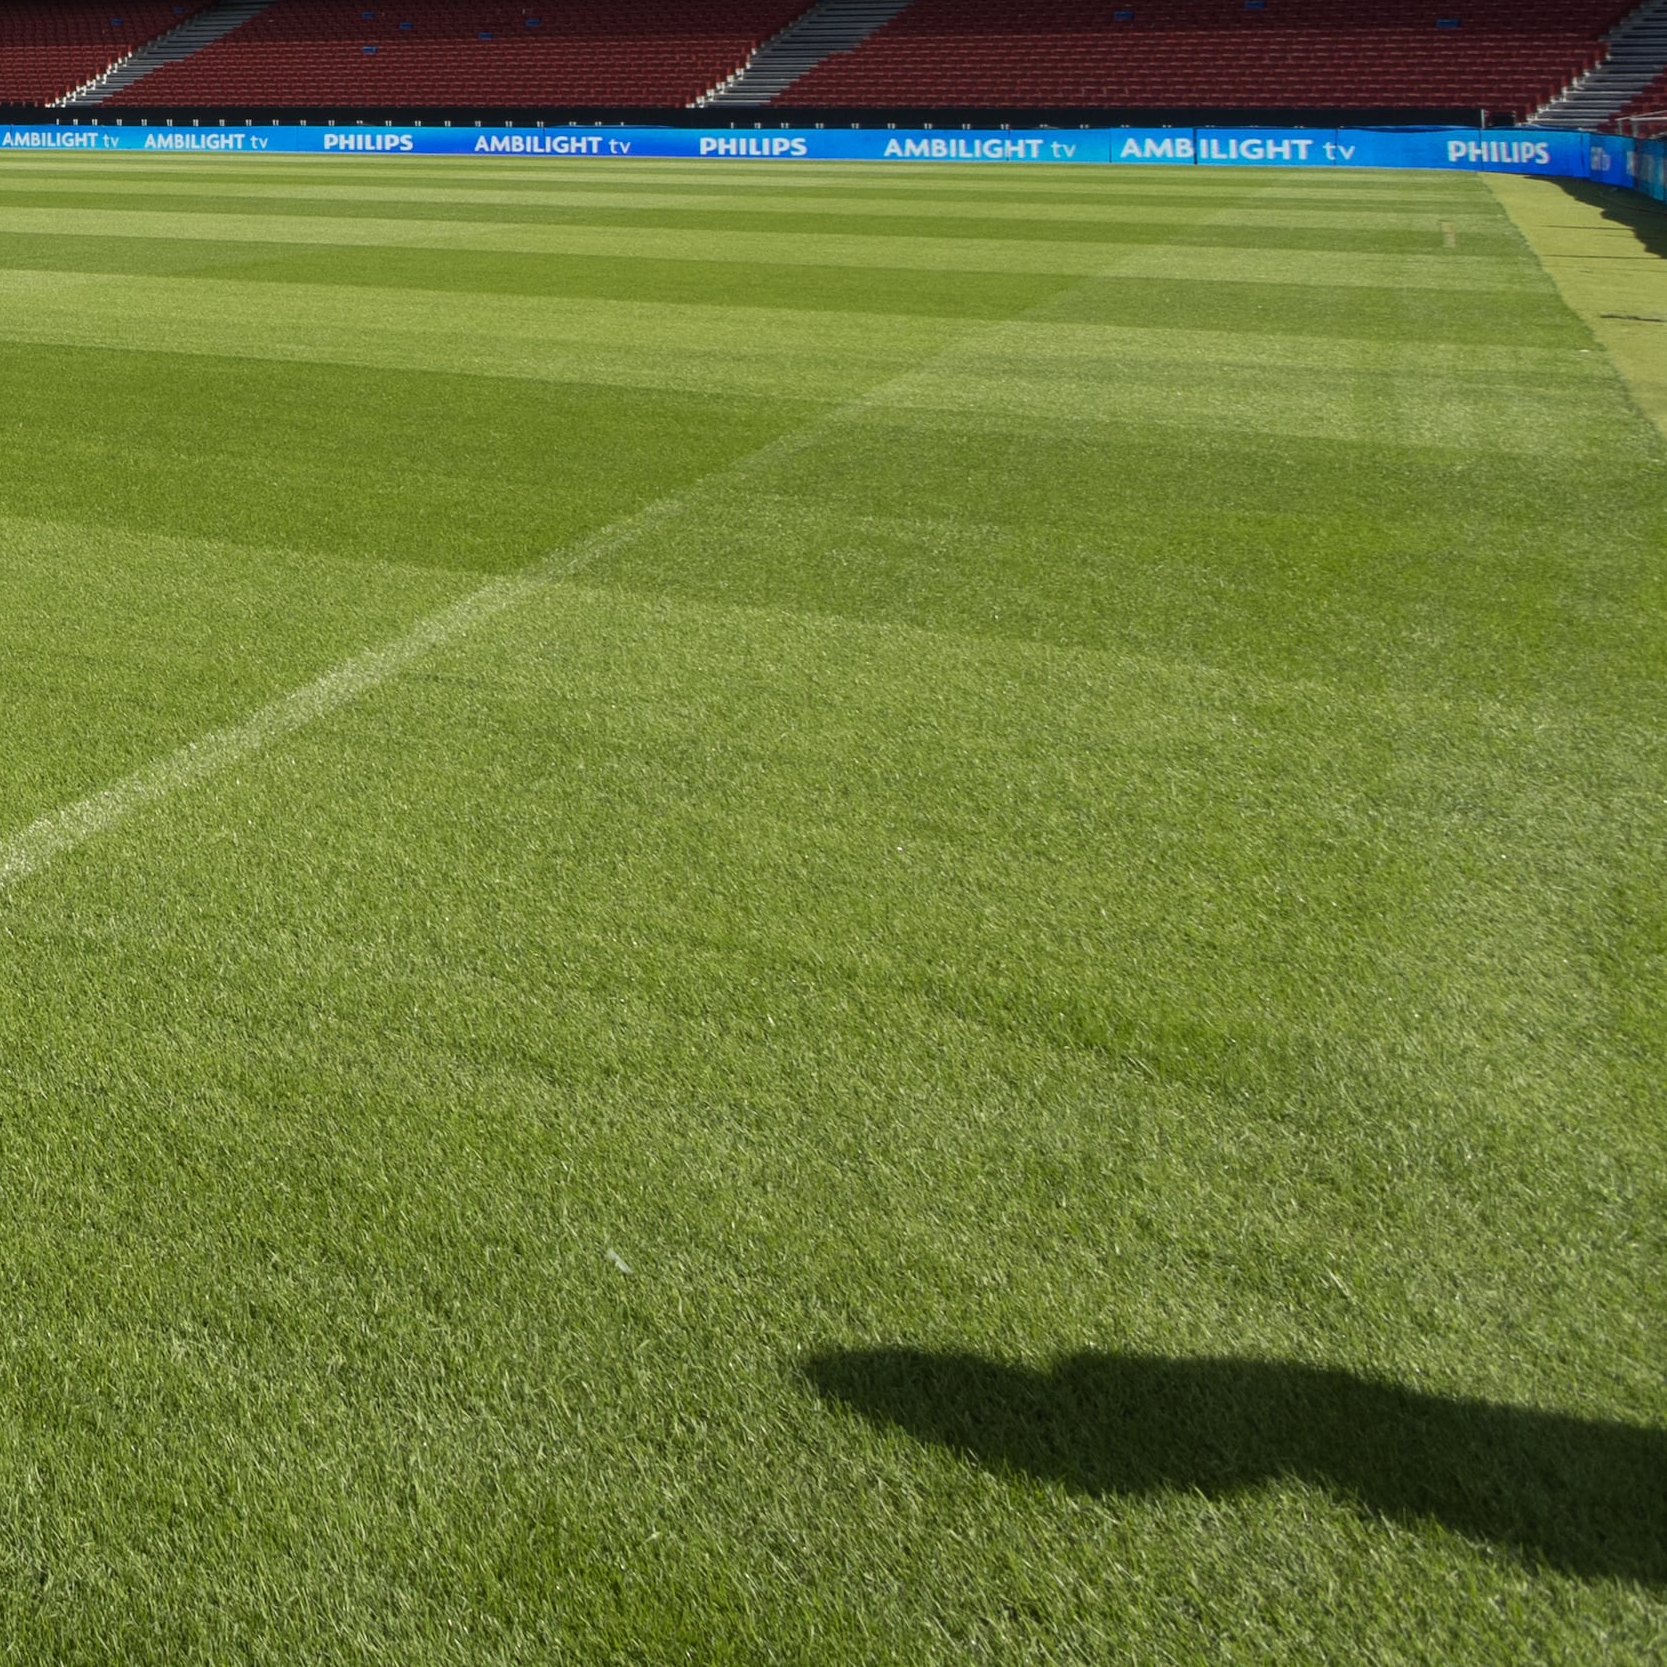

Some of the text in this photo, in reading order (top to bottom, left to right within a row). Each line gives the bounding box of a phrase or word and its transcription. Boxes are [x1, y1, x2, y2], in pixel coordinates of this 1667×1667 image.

[2, 132, 119, 148] AMBILIGHT tv
[145, 134, 268, 149] AMBILIGHT tv
[324, 133, 413, 150] PHILIPS
[475, 135, 631, 154] AMBILIGHT tv
[700, 138, 807, 157] PHILIPS
[884, 139, 1076, 158] AMBILIGHT tv
[1120, 138, 1355, 159] AMBILIGHT tv
[1448, 141, 1550, 165] PHILIPS
